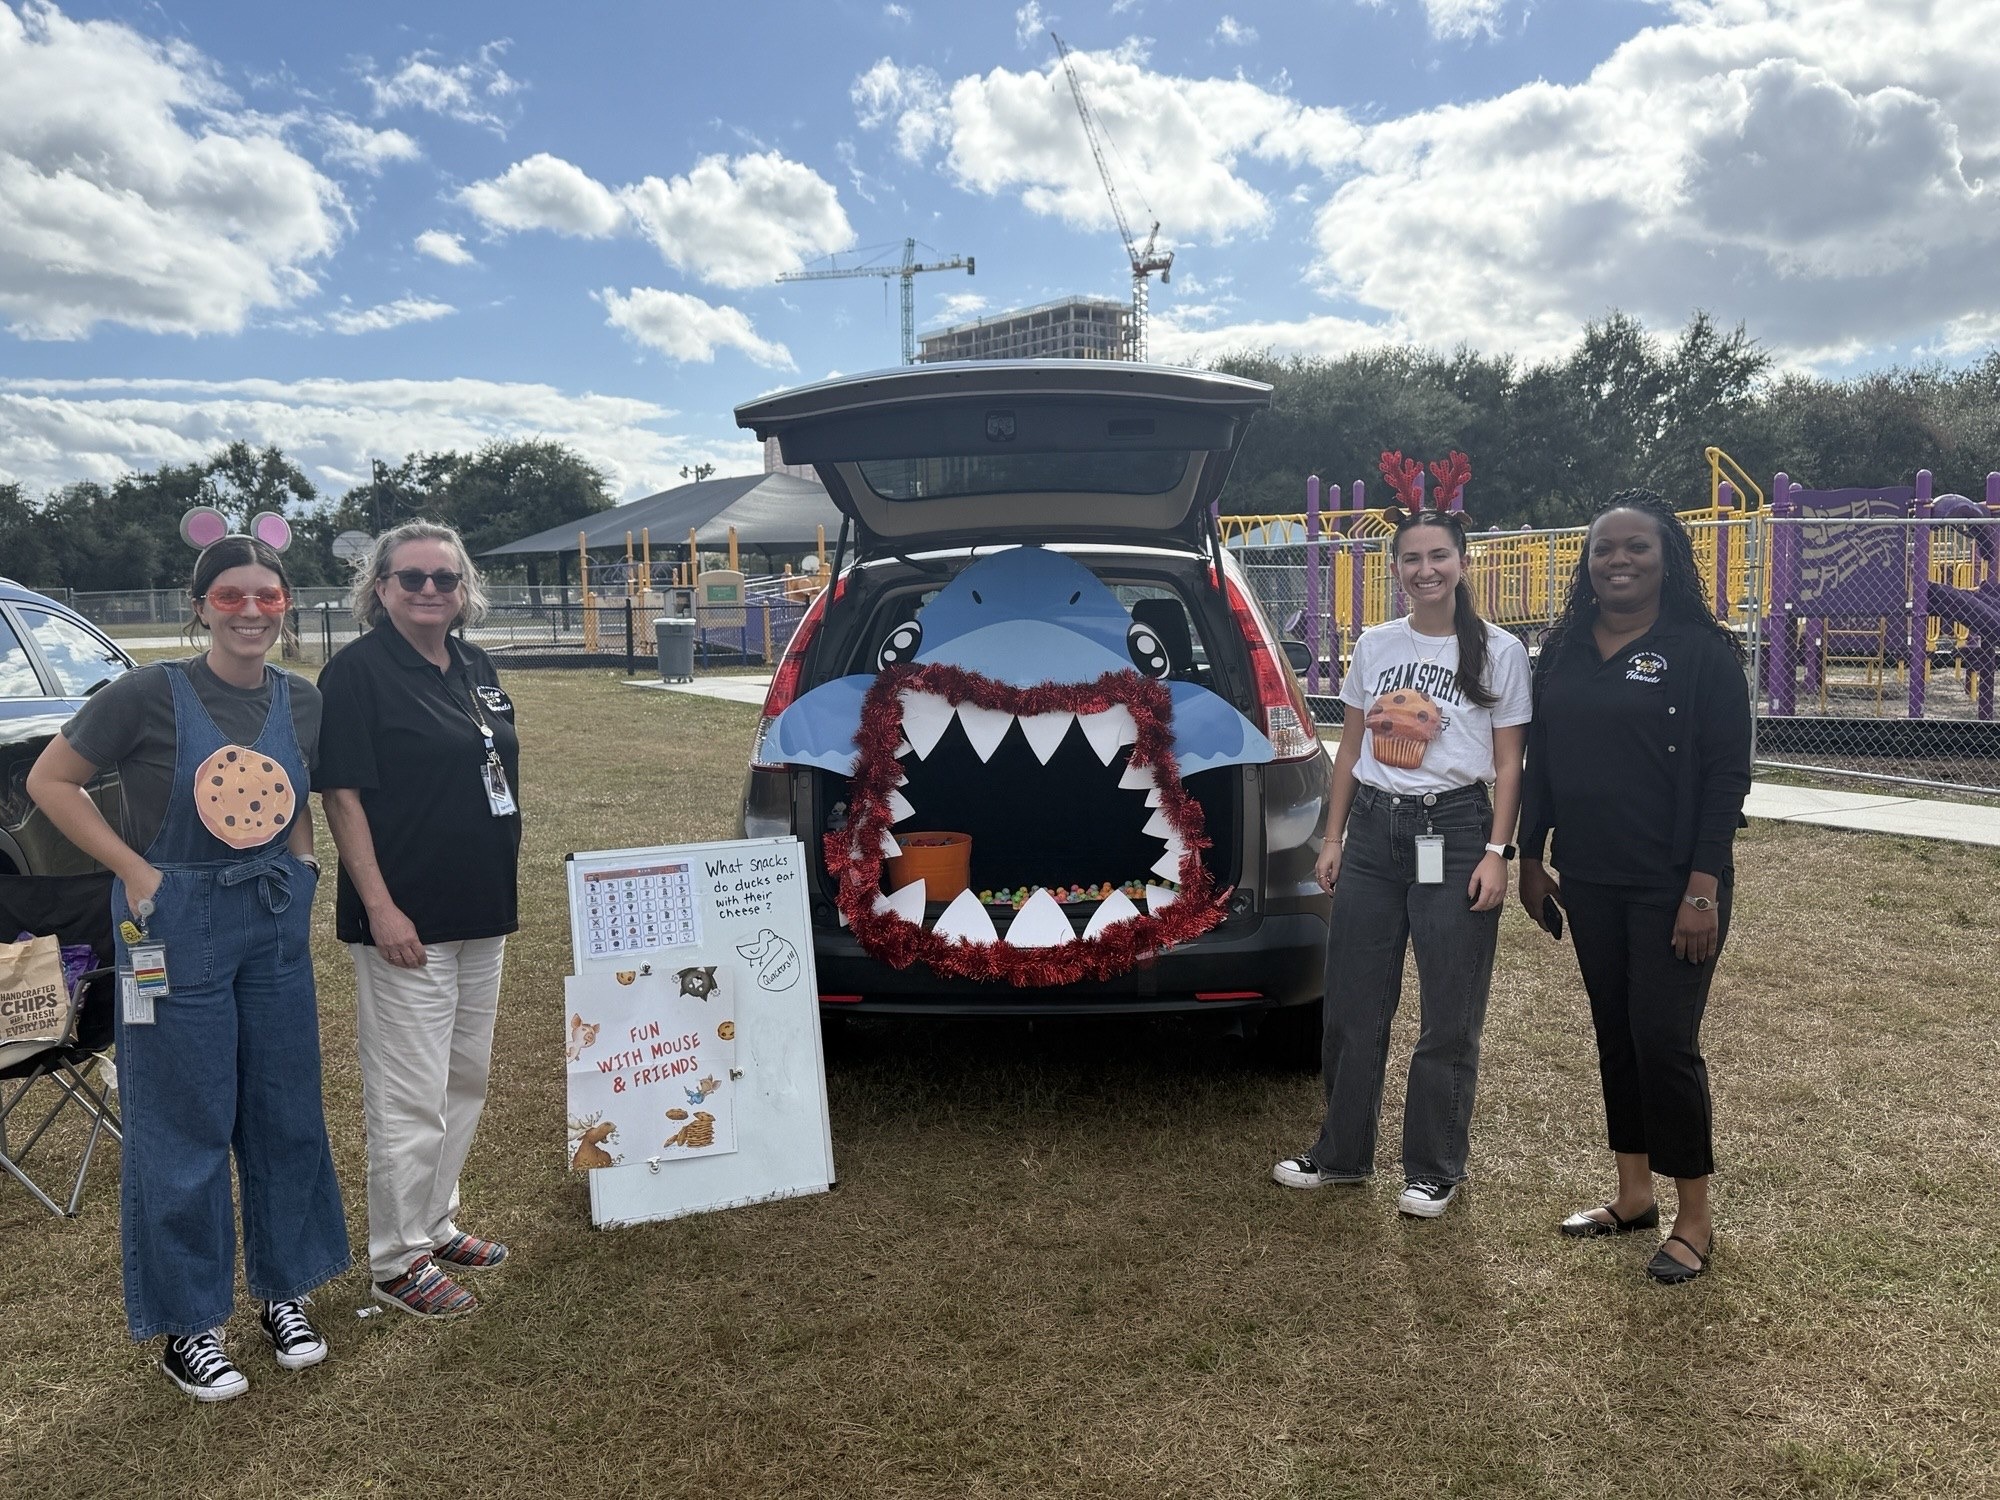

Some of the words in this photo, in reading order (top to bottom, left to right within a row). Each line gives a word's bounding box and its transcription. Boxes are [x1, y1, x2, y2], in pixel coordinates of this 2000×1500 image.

[1373, 662, 1418, 697] TEAM
[1625, 670, 1661, 684] Hornets
[705, 858, 744, 878] What
[714, 881, 729, 893] do
[735, 877, 771, 891] ducks
[776, 871, 795, 883] eat
[716, 895, 739, 908] with
[743, 891, 772, 904] their
[719, 906, 760, 919] cheese
[0, 984, 56, 1002] HANDCRAFTED
[1, 992, 58, 1017] CHIPS
[26, 1009, 55, 1021] FRESH
[630, 1021, 660, 1043] FUN
[596, 1048, 643, 1074] WITH
[650, 1032, 701, 1060] MOUSE
[613, 1076, 626, 1093] &
[633, 1055, 698, 1088] FRIENDS
